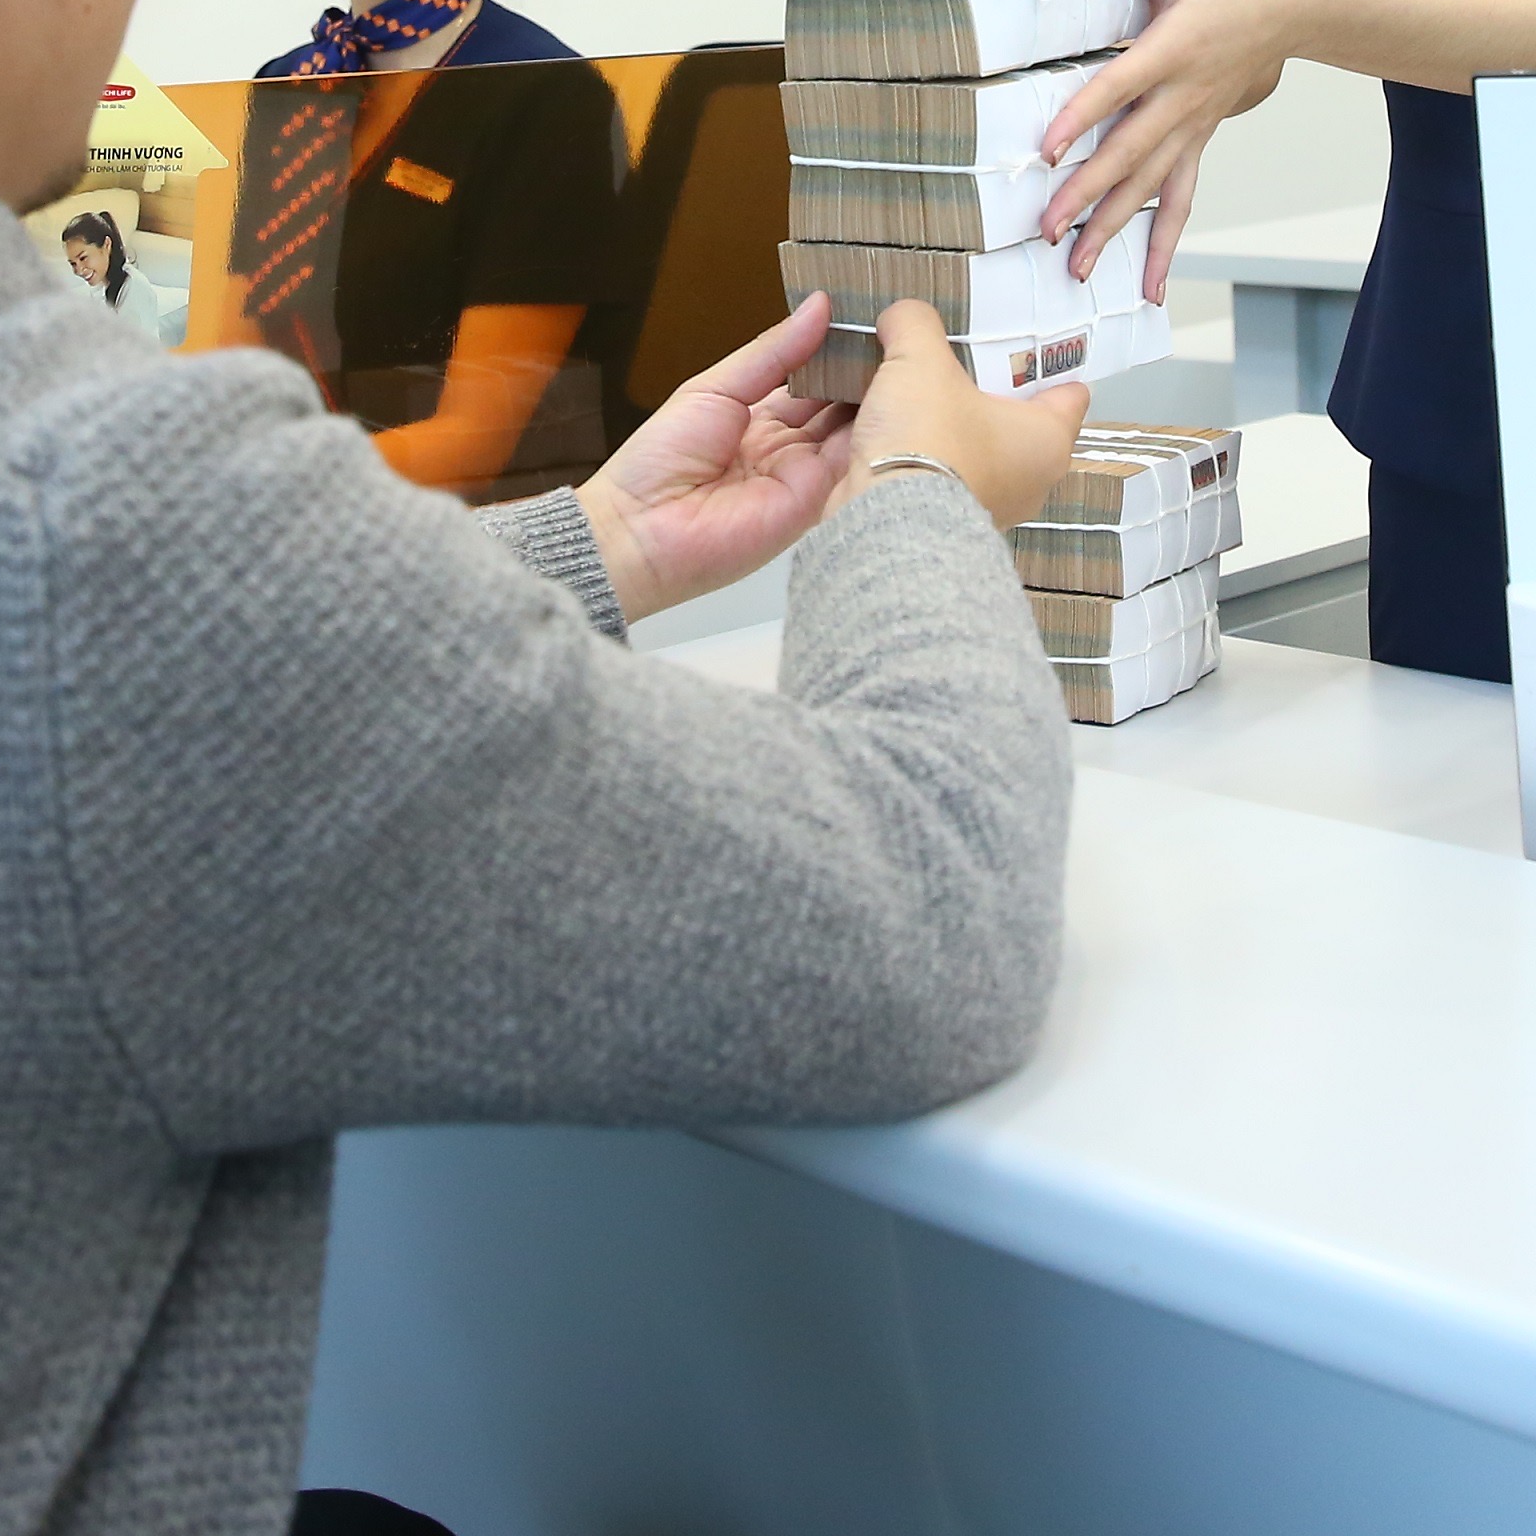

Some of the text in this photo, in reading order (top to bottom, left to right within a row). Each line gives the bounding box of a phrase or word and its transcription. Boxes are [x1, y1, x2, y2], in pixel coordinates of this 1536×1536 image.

[88, 145, 183, 163] THỊNH VƯỢNG
[1025, 337, 1084, 381] 20000
